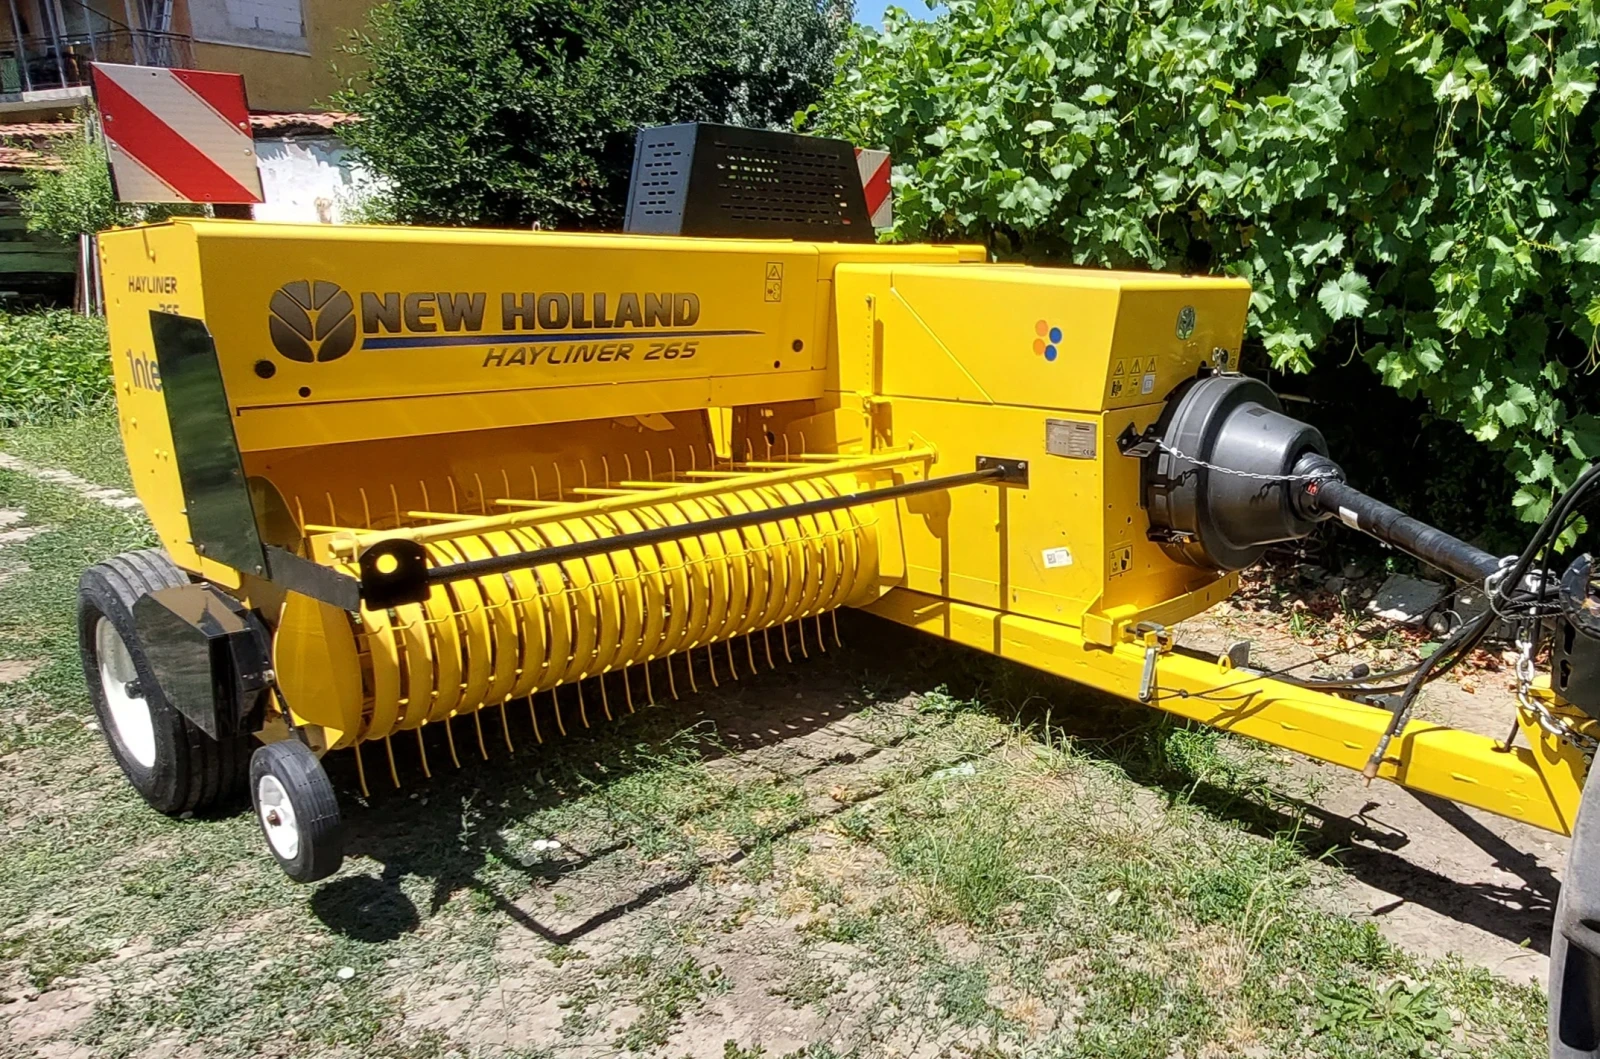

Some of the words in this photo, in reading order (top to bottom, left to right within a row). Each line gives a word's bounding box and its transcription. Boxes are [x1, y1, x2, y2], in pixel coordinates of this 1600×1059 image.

[128, 276, 178, 294] HAYLINER
[361, 292, 487, 333] NEW
[501, 292, 700, 331] HOLLAND
[482, 343, 635, 368] HAYLINER
[643, 341, 699, 361] 265
